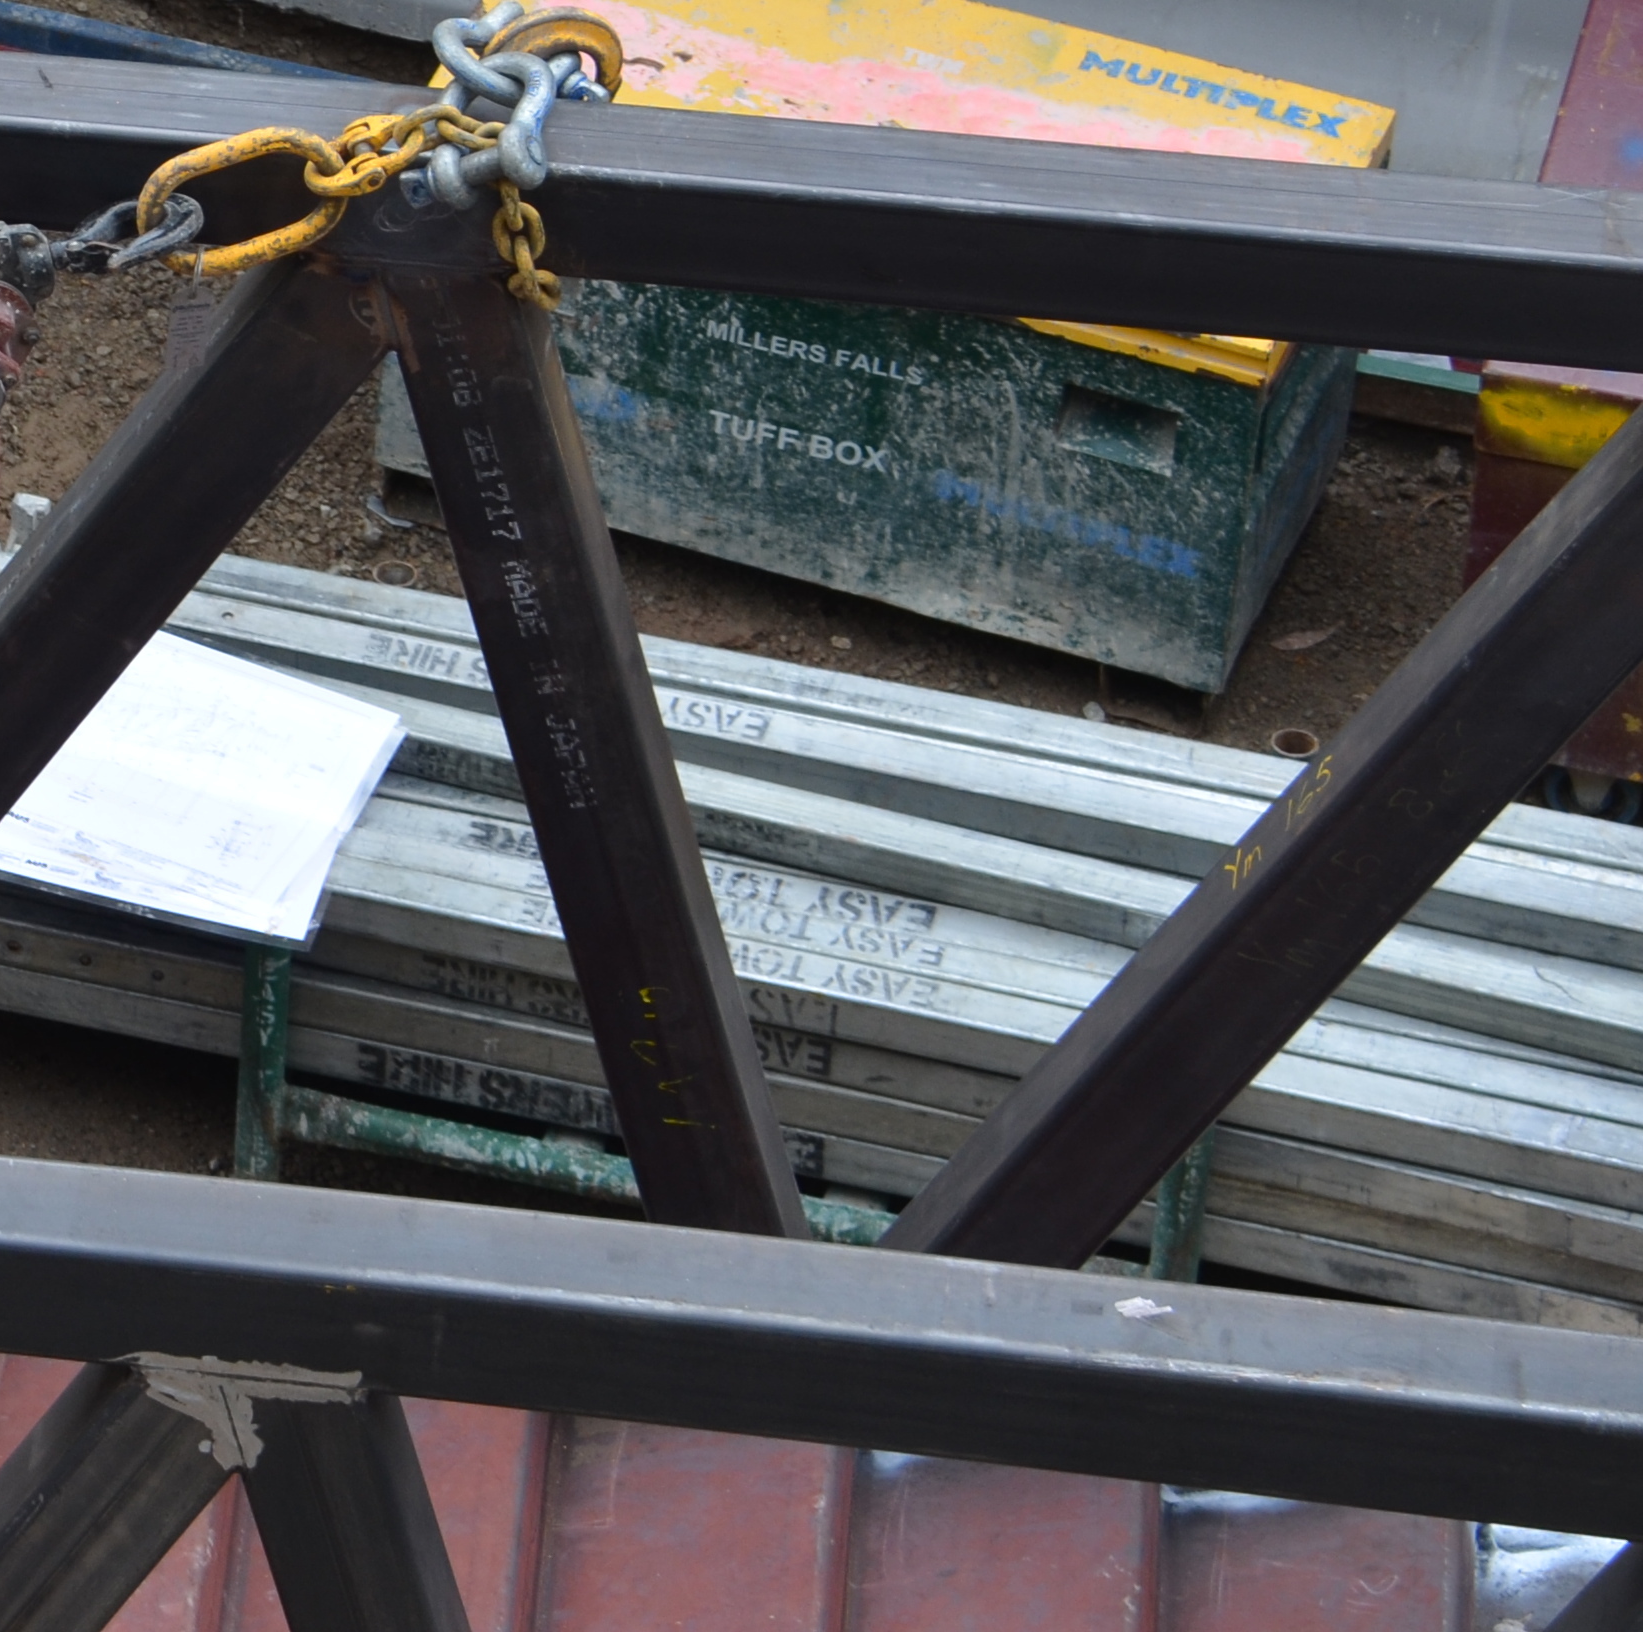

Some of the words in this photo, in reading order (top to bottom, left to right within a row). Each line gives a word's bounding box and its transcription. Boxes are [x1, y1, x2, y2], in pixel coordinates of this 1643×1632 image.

[1078, 48, 1350, 139] MULTIPLEX
[706, 318, 826, 364] MILLERS
[836, 348, 923, 386] FALLS
[710, 409, 799, 451] TUFF
[810, 435, 891, 473] BOX
[502, 559, 550, 639] MADE
[530, 659, 566, 696] IN
[805, 885, 937, 930] EASY
[829, 924, 947, 968] EASY
[822, 962, 947, 1009] EASY
[752, 1024, 833, 1077] EAS
